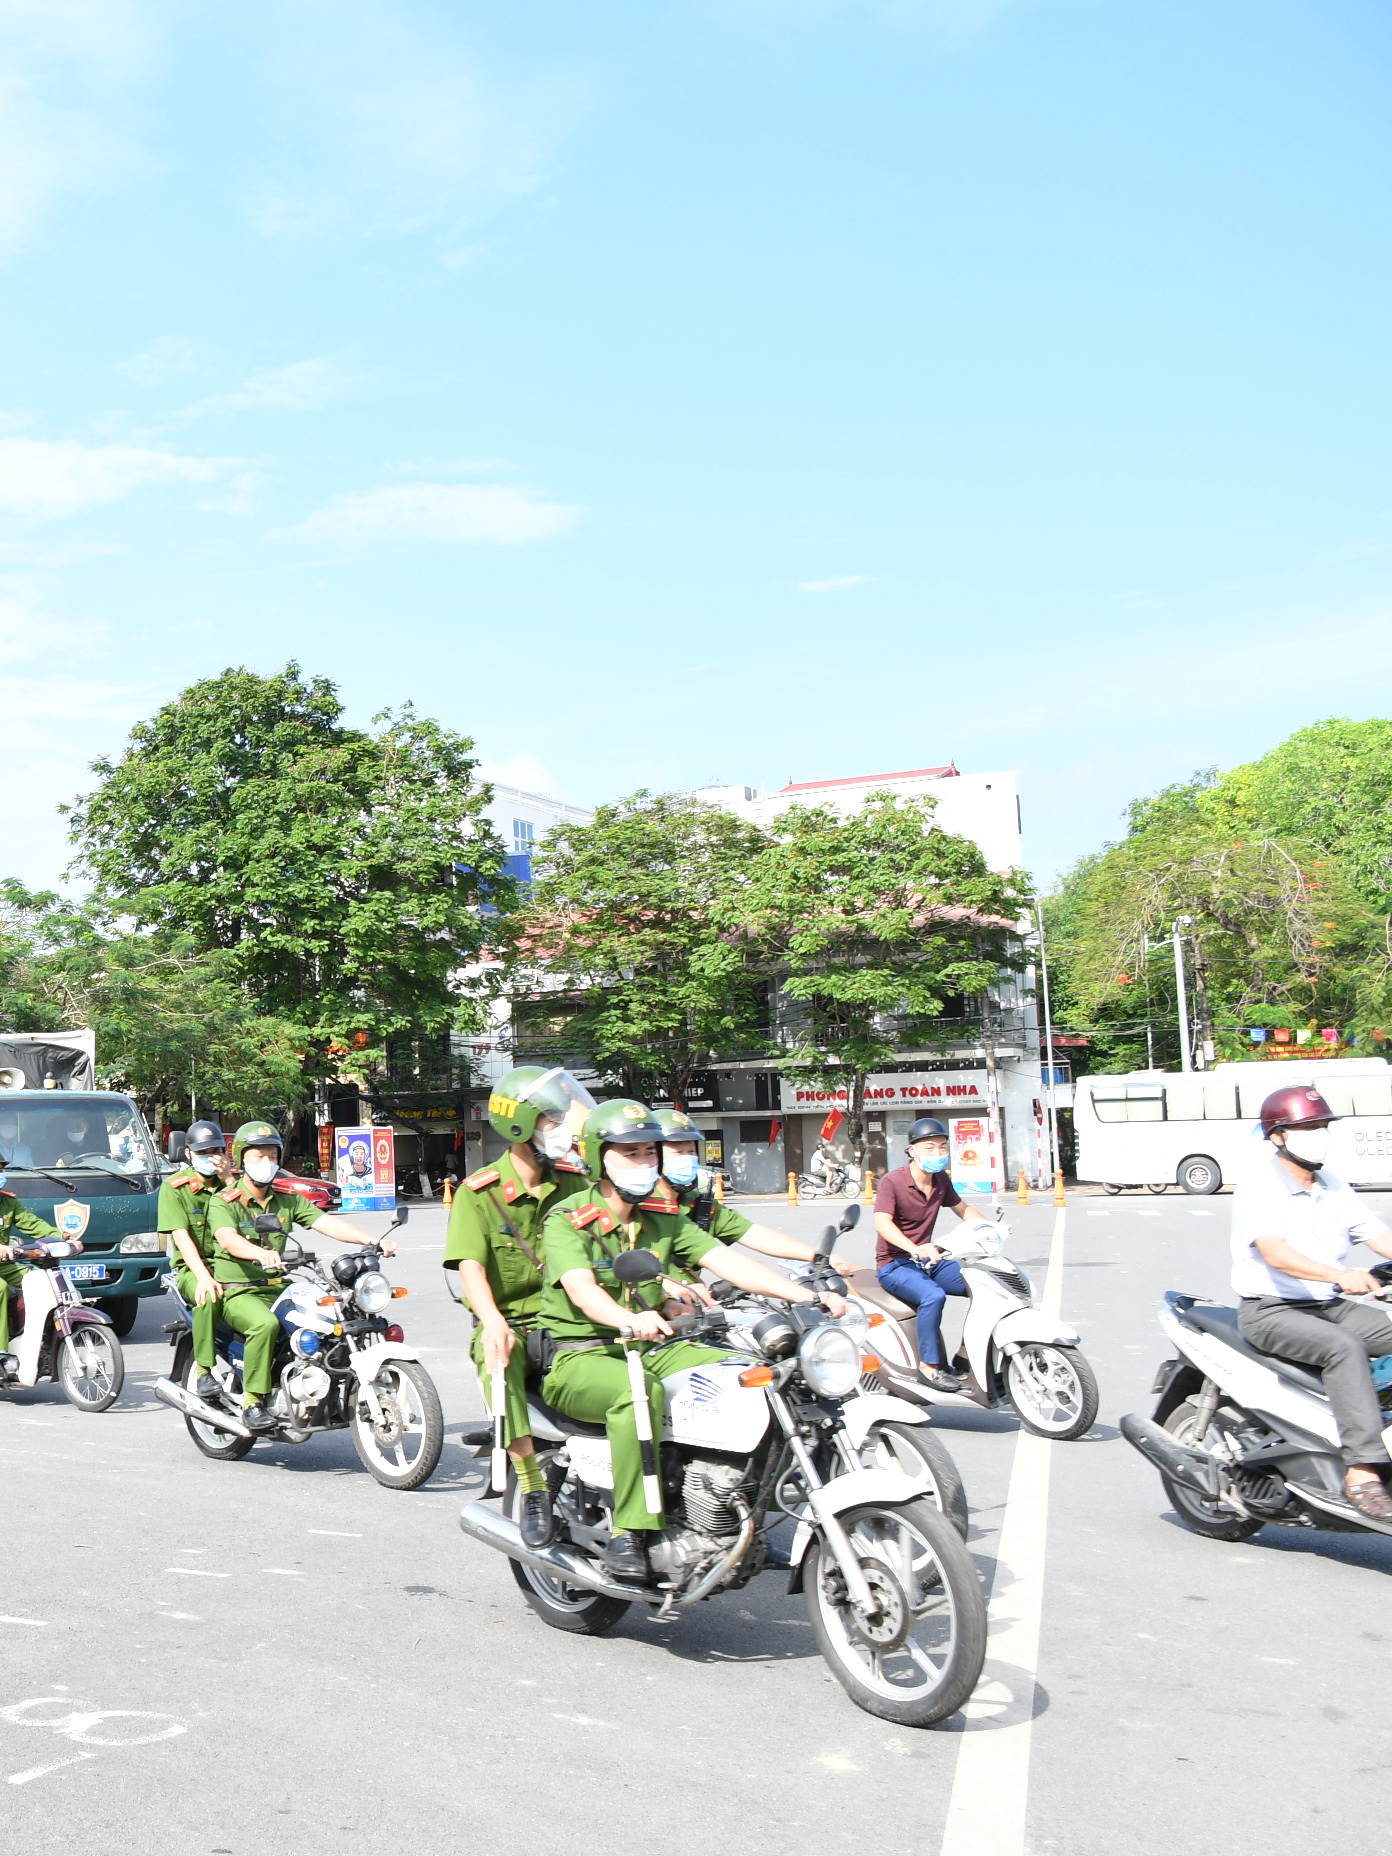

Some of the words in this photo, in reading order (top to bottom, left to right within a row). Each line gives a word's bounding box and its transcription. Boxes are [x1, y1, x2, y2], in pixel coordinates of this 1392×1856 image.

[862, 1086, 896, 1099] ĂNG
[900, 1083, 942, 1098] TOÀN
[946, 1084, 979, 1097] NHA
[65, 1266, 100, 1279] A-0815
